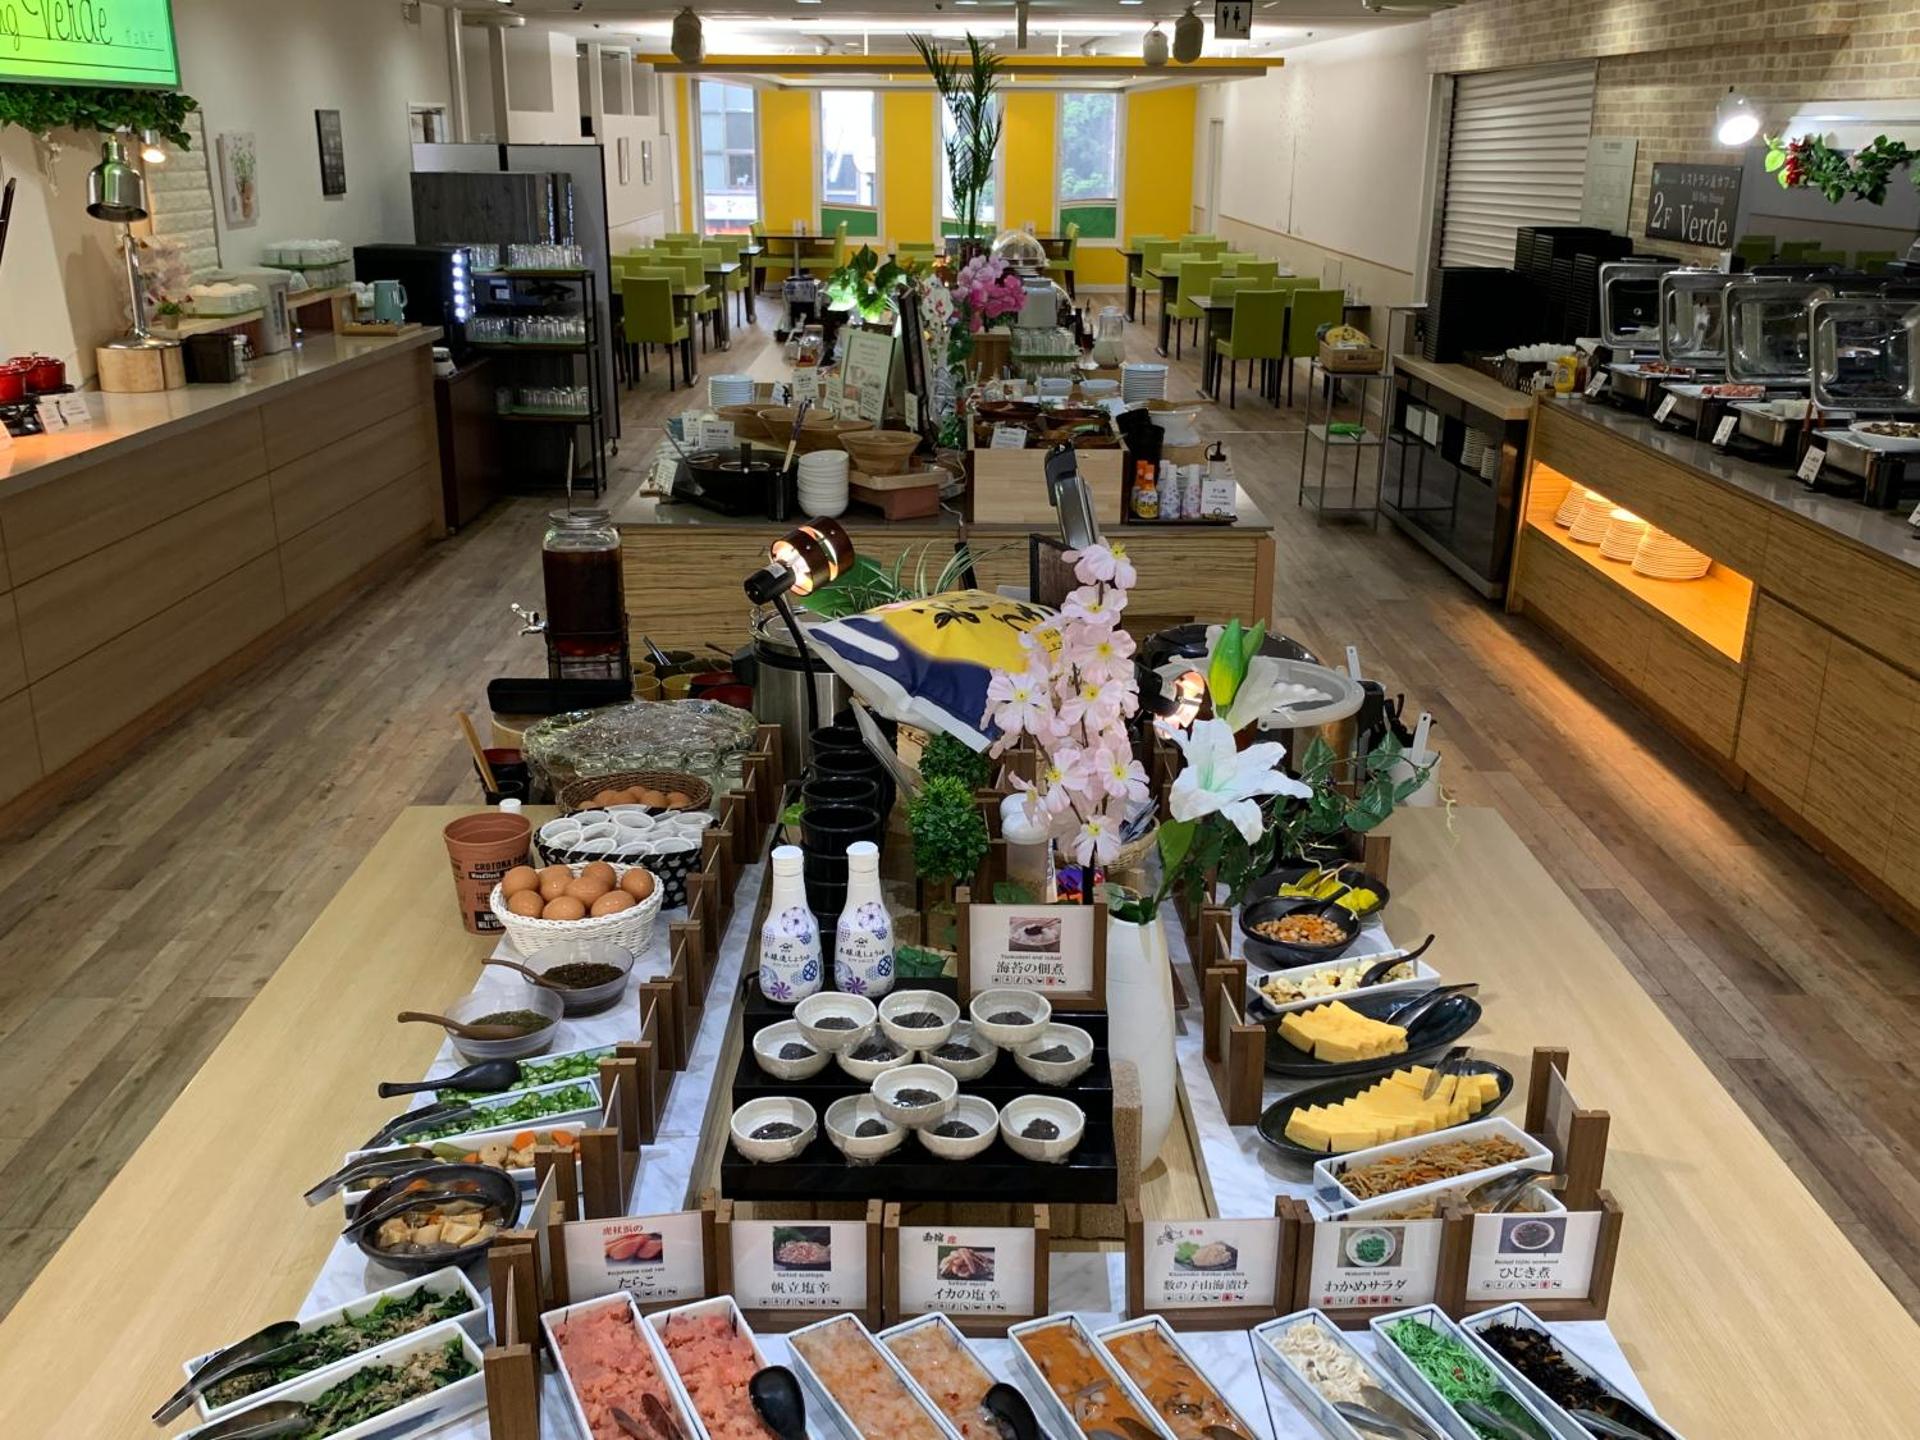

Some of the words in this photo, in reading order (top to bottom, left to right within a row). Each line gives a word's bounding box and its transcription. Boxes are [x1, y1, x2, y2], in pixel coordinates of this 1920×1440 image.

[1680, 204, 1728, 246] Verde
[996, 961, 1065, 975] 海苔の佃煮
[1499, 1266, 1552, 1279] ひじき煮
[618, 1275, 656, 1288] たらこ
[771, 1281, 830, 1294] 帆立塩辛
[1163, 1279, 1250, 1291] 数の子山海漬け
[1324, 1279, 1408, 1292] わかめサラダ
[934, 1288, 1000, 1301] イカの塩辛
